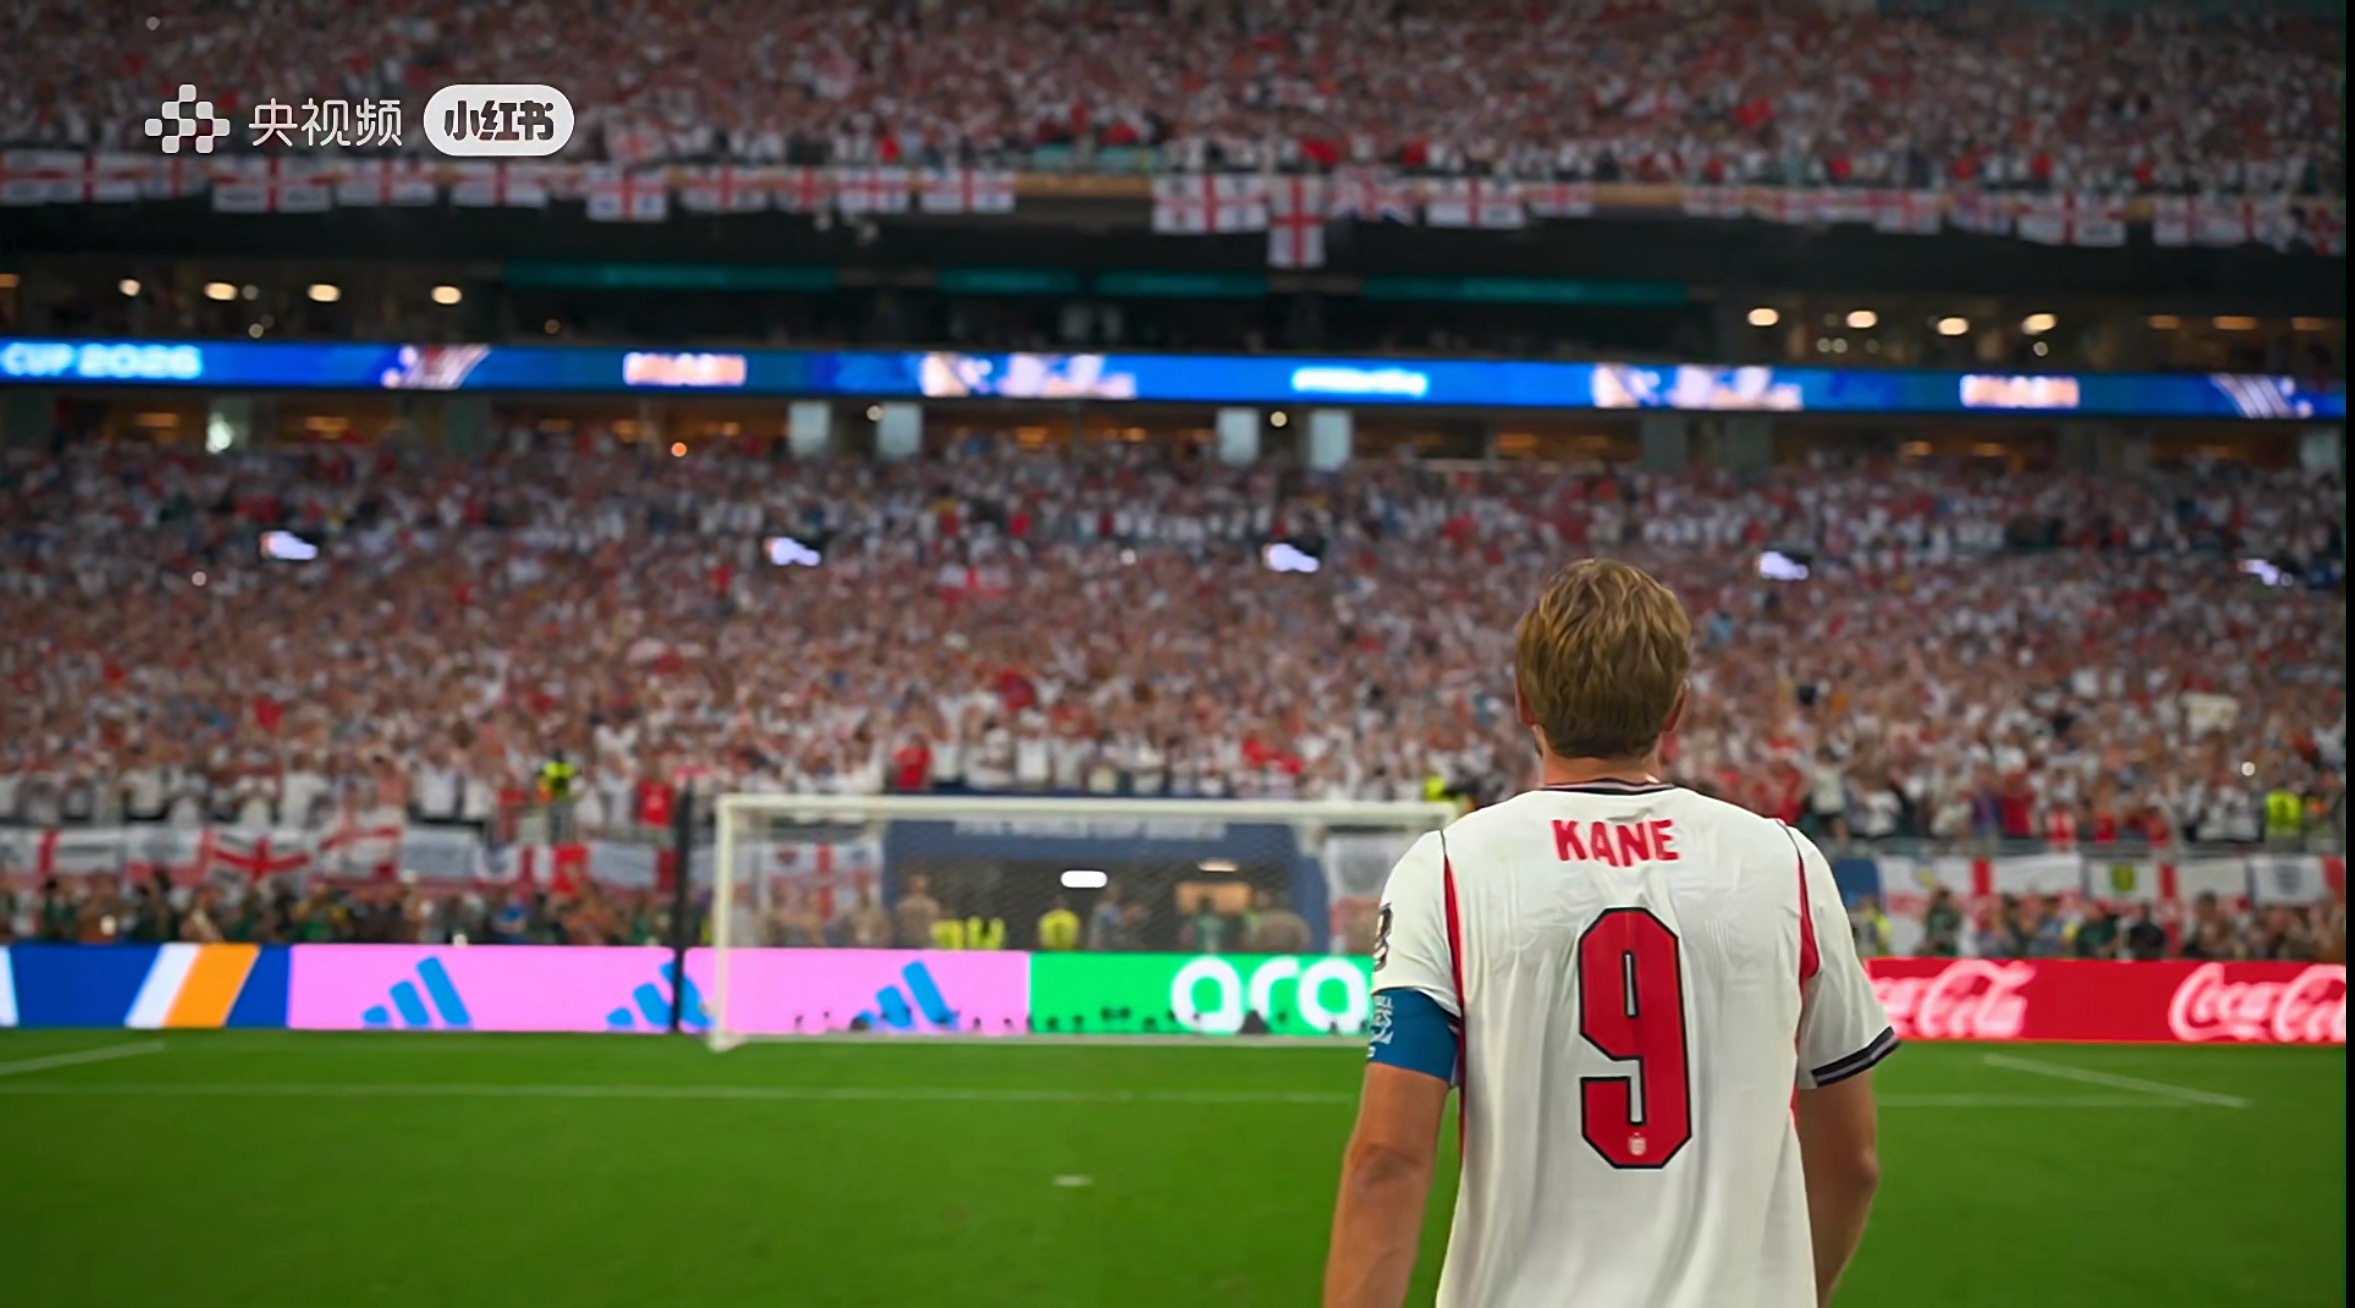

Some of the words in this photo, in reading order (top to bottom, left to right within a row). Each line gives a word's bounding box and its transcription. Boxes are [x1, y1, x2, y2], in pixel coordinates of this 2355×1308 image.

[2, 342, 73, 376] CUP
[1551, 818, 1680, 868] KANE
[1171, 955, 1371, 1036] ara
[1579, 907, 1692, 1169] 9
